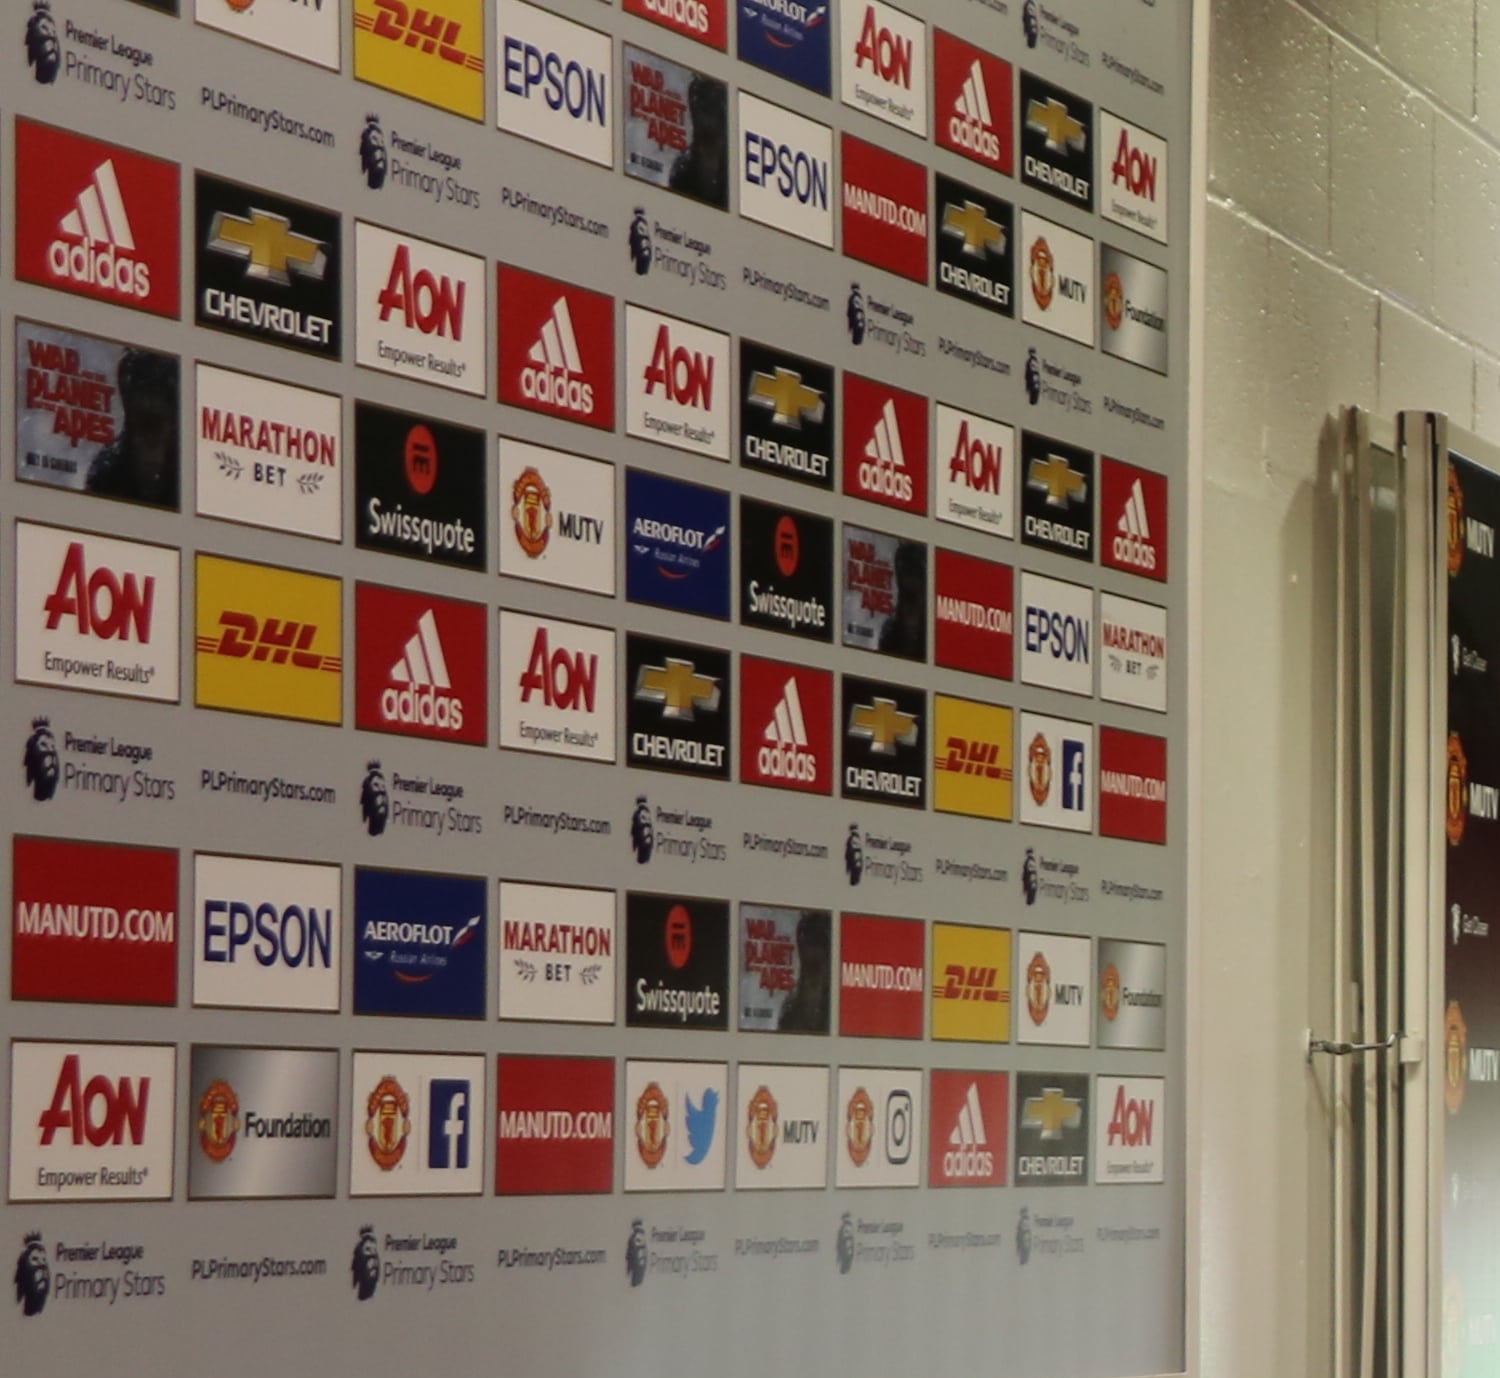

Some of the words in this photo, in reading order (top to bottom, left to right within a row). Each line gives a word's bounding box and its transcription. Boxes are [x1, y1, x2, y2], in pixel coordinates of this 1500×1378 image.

[66, 20, 109, 50] Premier
[112, 32, 153, 67] League
[373, 0, 466, 65] DHL
[66, 52, 131, 101] Primary
[135, 74, 176, 110] Stars
[505, 36, 606, 127] EPSON
[201, 86, 335, 149] PLPrimaryStars.com
[950, 115, 999, 162] adidas
[745, 133, 827, 211] EPSON
[1025, 155, 1090, 199] CHEVROLET
[845, 183, 926, 238] MANUTD.COM
[50, 231, 150, 299] adidas
[941, 262, 1010, 305] CHEVROLET
[1059, 272, 1087, 304] MUTV
[205, 286, 332, 346] CHEVROLET
[27, 340, 80, 375] WAR
[26, 367, 116, 413] PLANET
[520, 357, 594, 415] adidas
[53, 405, 114, 447] APES
[201, 406, 336, 468] MARATHON
[253, 461, 287, 488] BET
[747, 434, 829, 477] CHEVROLET
[859, 449, 912, 501] adidas
[369, 497, 474, 554] Swissquote
[558, 510, 604, 545] MUTV
[633, 516, 706, 549] AEROFLOT
[1025, 516, 1089, 551] CHEVROLET
[1113, 529, 1155, 570] adidas
[749, 581, 826, 629] Swissquote
[937, 594, 1012, 637] MANUTD.COM
[216, 610, 323, 670] DHL
[1025, 606, 1089, 664] EPSON
[1103, 620, 1164, 659] MARATHON
[45, 651, 102, 679] Empower
[381, 682, 463, 731] adidas
[65, 731, 107, 758] Premier
[110, 737, 152, 765] League
[633, 733, 724, 768] CHEVROLET
[758, 741, 816, 783] adidas
[944, 737, 1005, 781] DHL
[65, 761, 129, 801] Primary
[132, 771, 175, 801] Stars
[201, 769, 335, 804] PLPrimaryStars.com
[847, 766, 921, 798] CHEVROLET
[1101, 769, 1165, 801] MANUTD.COM
[18, 901, 174, 944] MANUTD.COM
[203, 900, 332, 969] EPSON
[363, 921, 454, 946] AEROFLOT
[503, 920, 611, 958] MARATHON
[545, 963, 571, 982] BET
[842, 962, 923, 993] MANUTD.COM
[945, 965, 999, 1002] DHL
[637, 979, 720, 1023] Swissquote
[1055, 984, 1083, 1006] MUTV
[245, 1111, 330, 1140] Foundation
[501, 1111, 612, 1139] MANUTD.COM
[784, 1120, 820, 1145] MUTV
[943, 1150, 993, 1176] adidas
[1018, 1155, 1083, 1176] CHEVROLET
[54, 1272, 119, 1305] Primary
[122, 1271, 165, 1296] Stars
[192, 1256, 326, 1283] PLPrimaryStars.com
